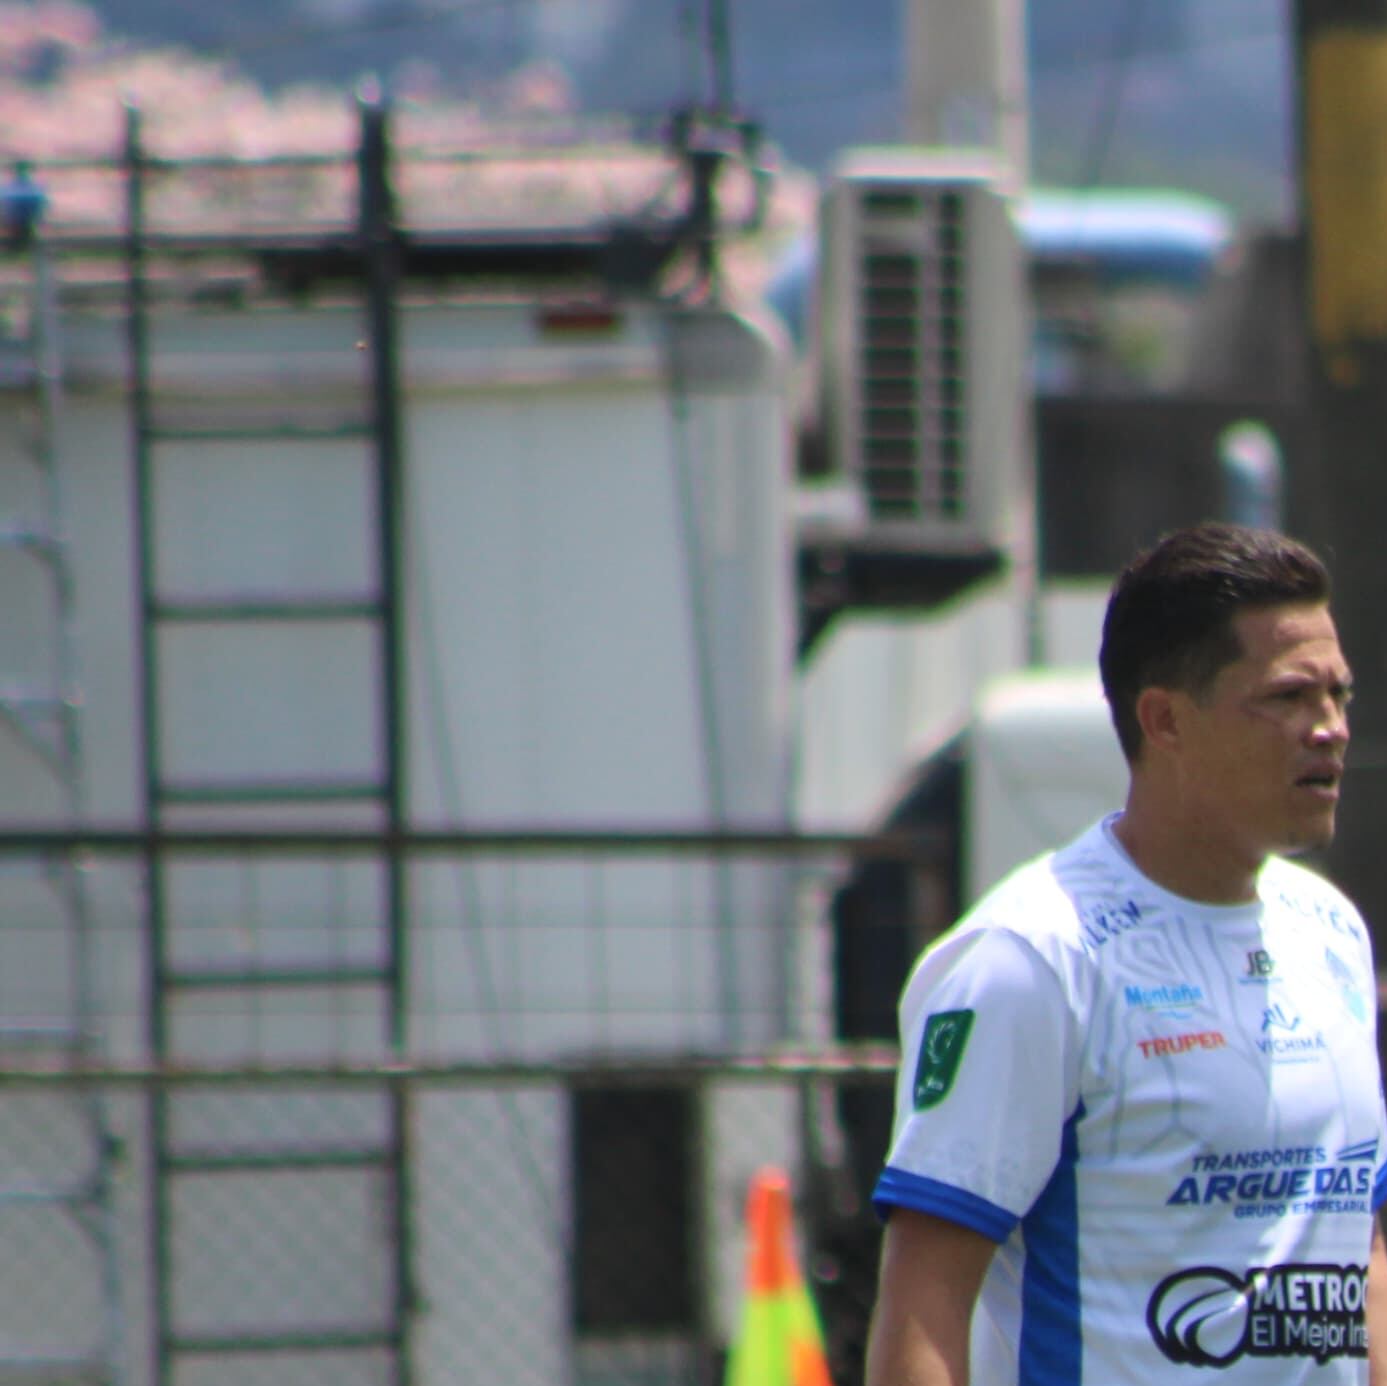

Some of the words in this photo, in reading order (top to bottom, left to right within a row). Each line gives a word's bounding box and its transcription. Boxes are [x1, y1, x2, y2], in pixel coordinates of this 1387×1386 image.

[1136, 1031, 1227, 1058] TRUPER
[1193, 1147, 1327, 1171] TRANSPORTES
[1166, 1167, 1371, 1206] ARGUEDAS
[1234, 1202, 1286, 1219] GRUPO
[1252, 1316, 1276, 1346] El
[1285, 1315, 1346, 1355] Mejor
